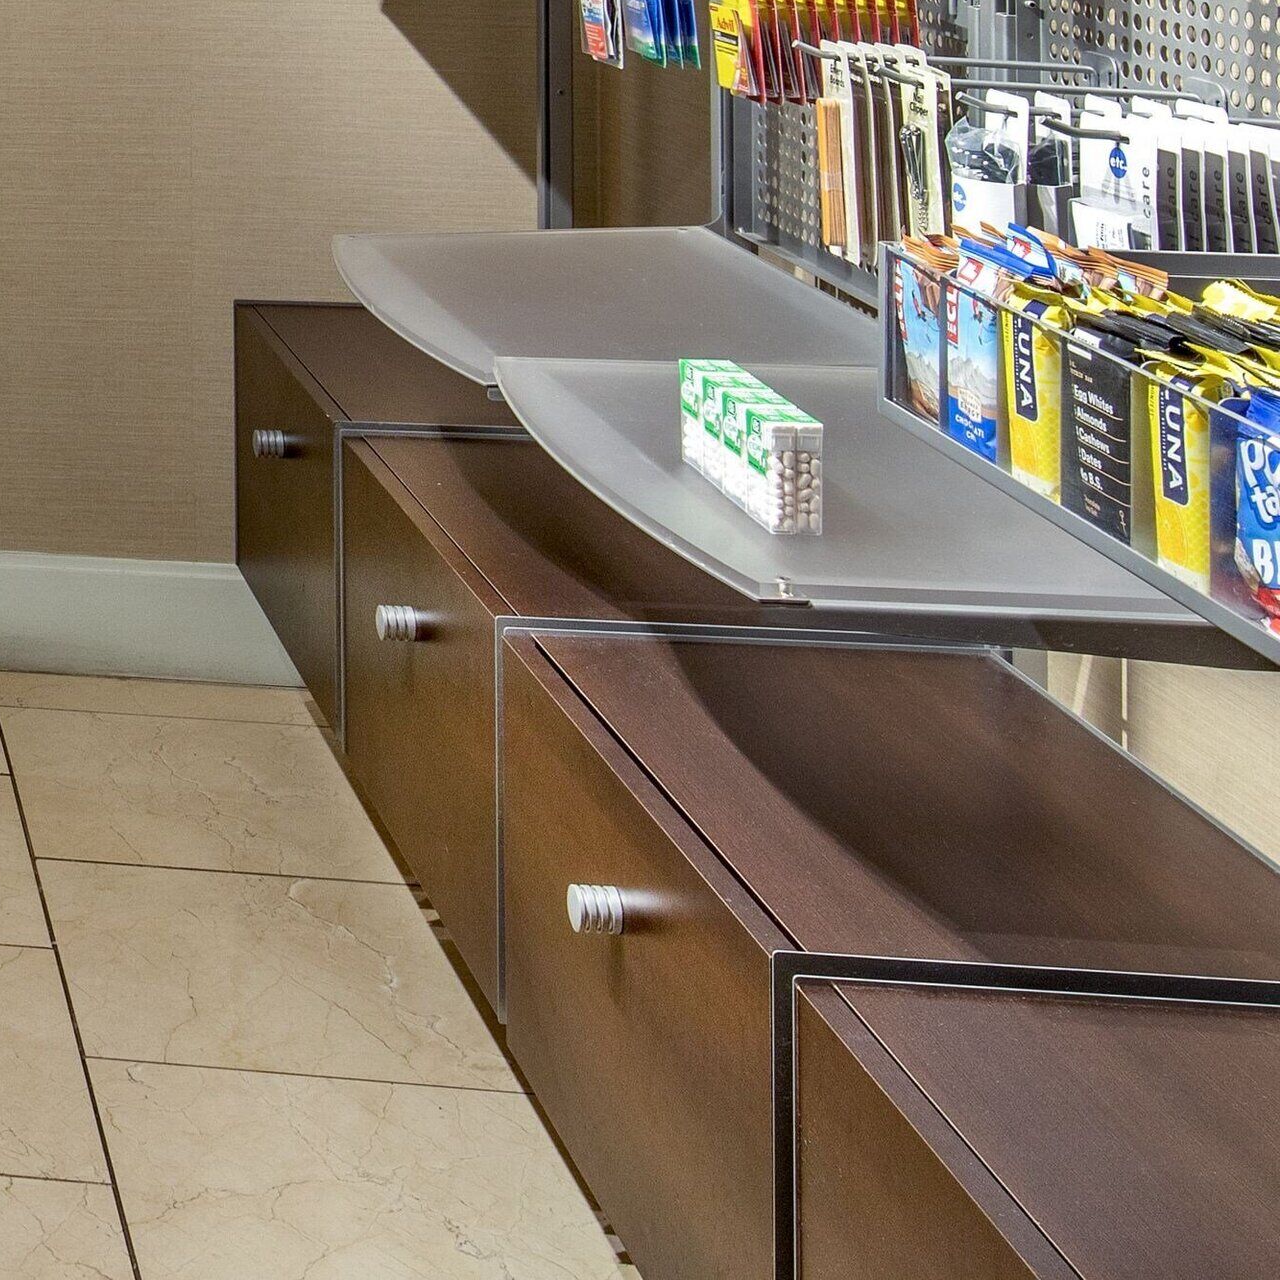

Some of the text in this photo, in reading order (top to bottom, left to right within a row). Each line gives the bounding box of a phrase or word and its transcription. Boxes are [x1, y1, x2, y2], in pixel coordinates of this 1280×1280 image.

[1110, 157, 1127, 171] etc.
[1142, 167, 1151, 218] care
[1074, 385, 1113, 415] Egg Whites
[1077, 408, 1107, 432] Almonds
[1080, 428, 1110, 454] Cashews
[1082, 450, 1102, 470] Dates
